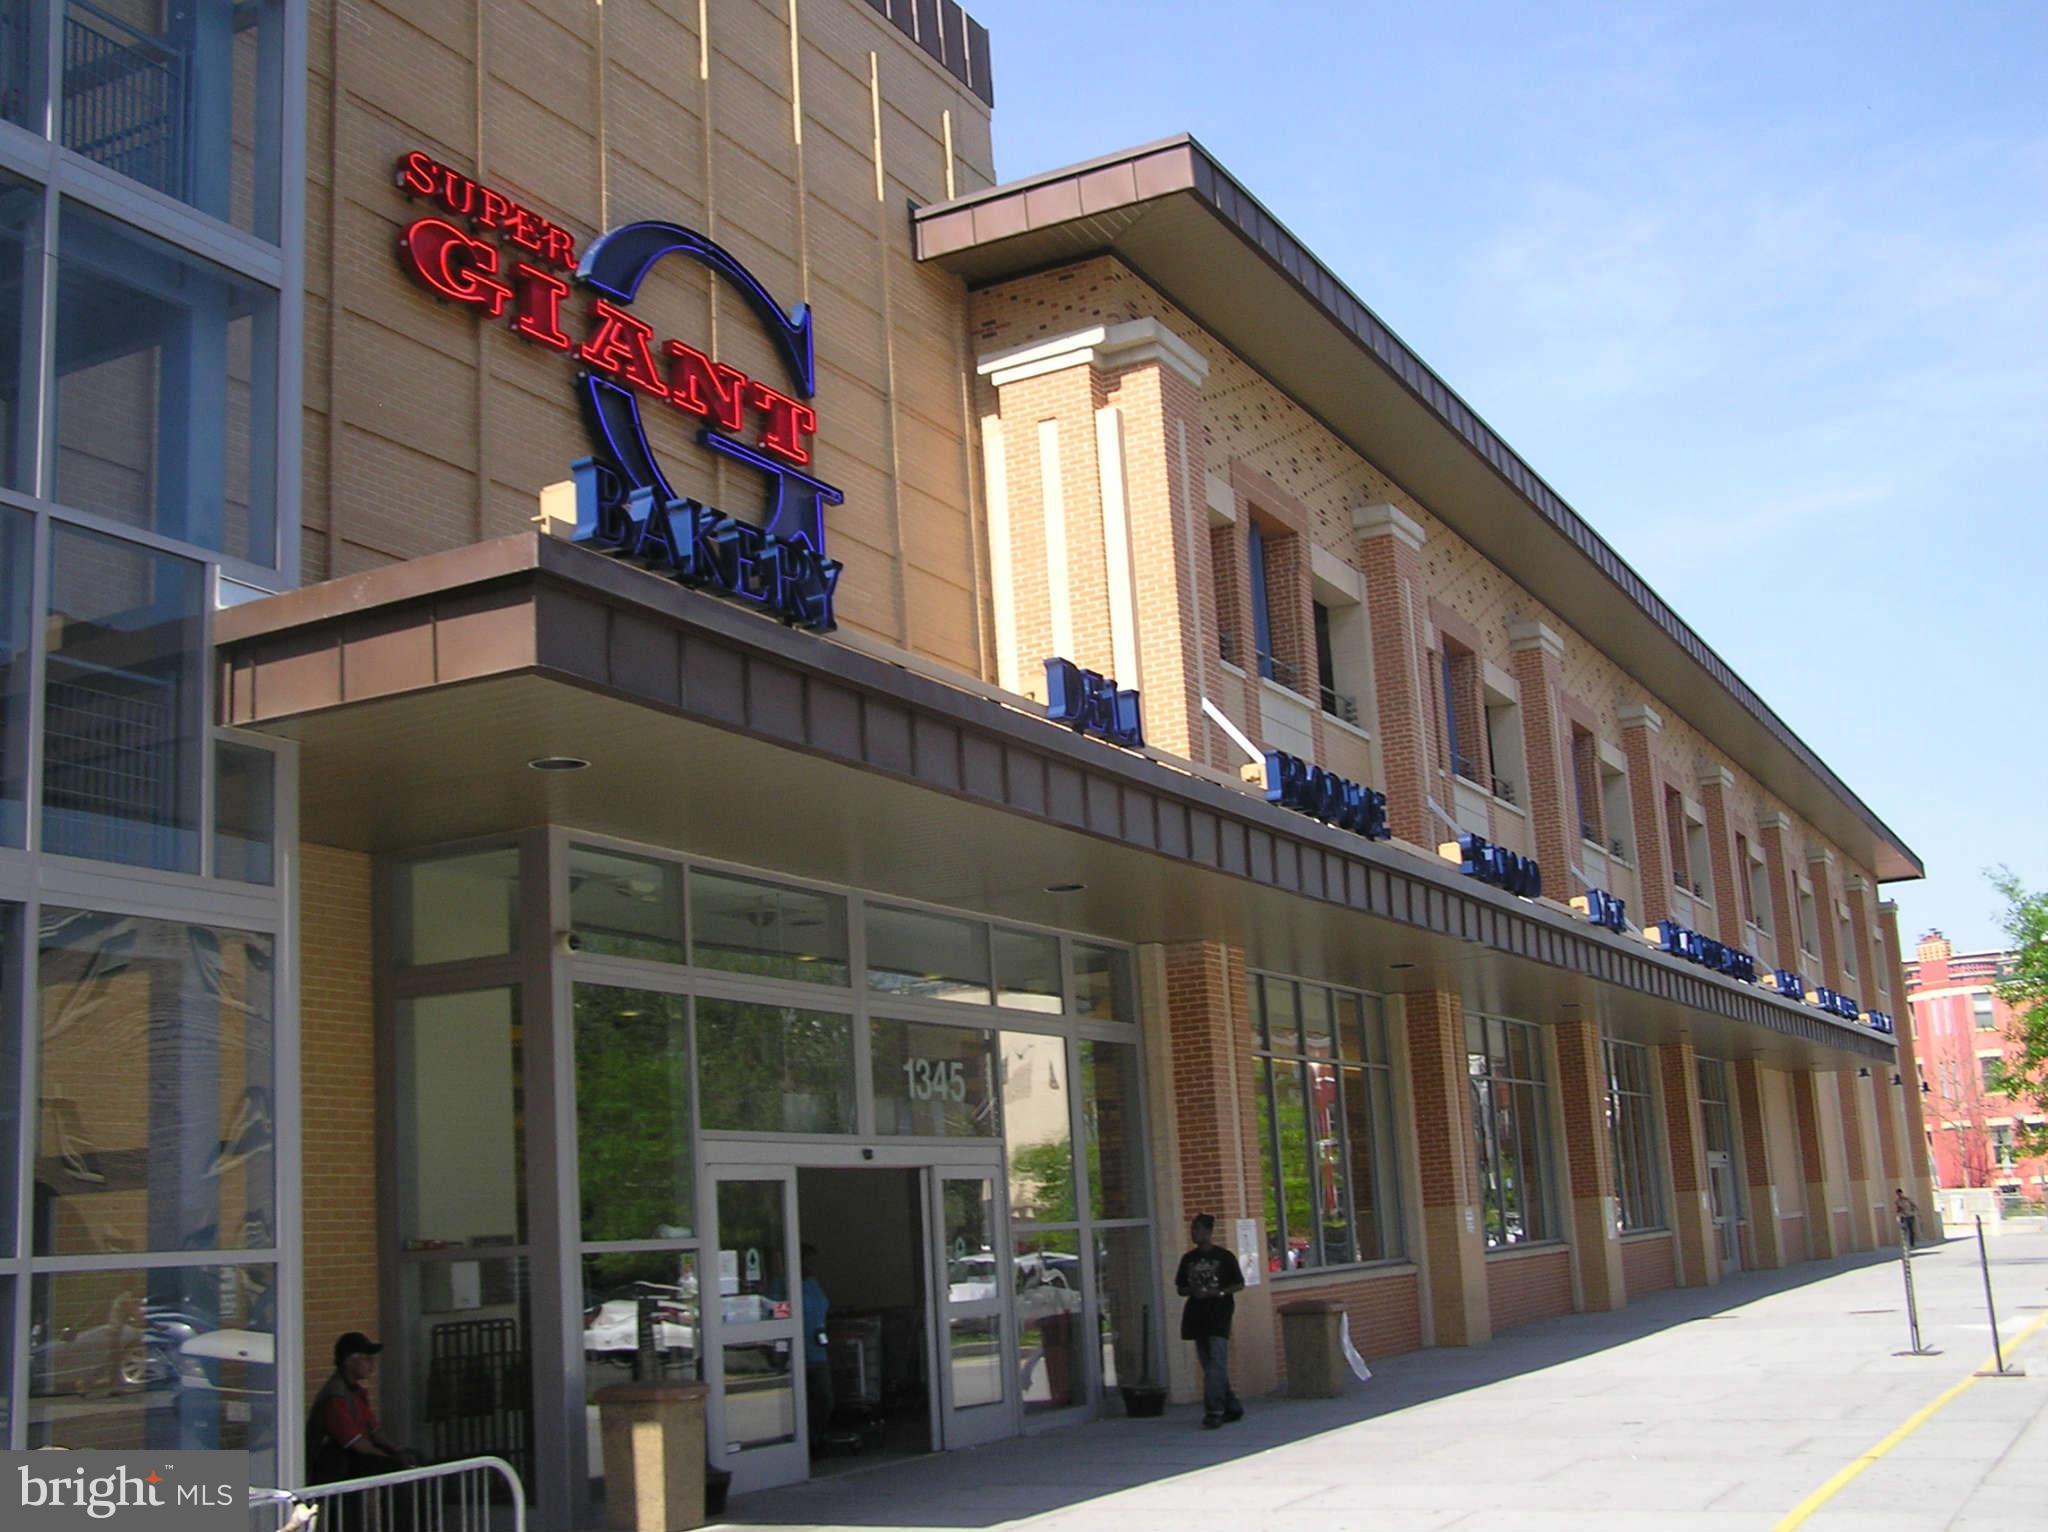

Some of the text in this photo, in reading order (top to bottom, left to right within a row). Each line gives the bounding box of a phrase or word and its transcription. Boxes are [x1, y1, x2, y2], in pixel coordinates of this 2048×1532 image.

[398, 150, 579, 271] SUPER
[400, 216, 816, 465] GIANT
[570, 455, 843, 632] BAKERY
[1042, 656, 1144, 749] DELI
[903, 1056, 967, 1103] 1345
